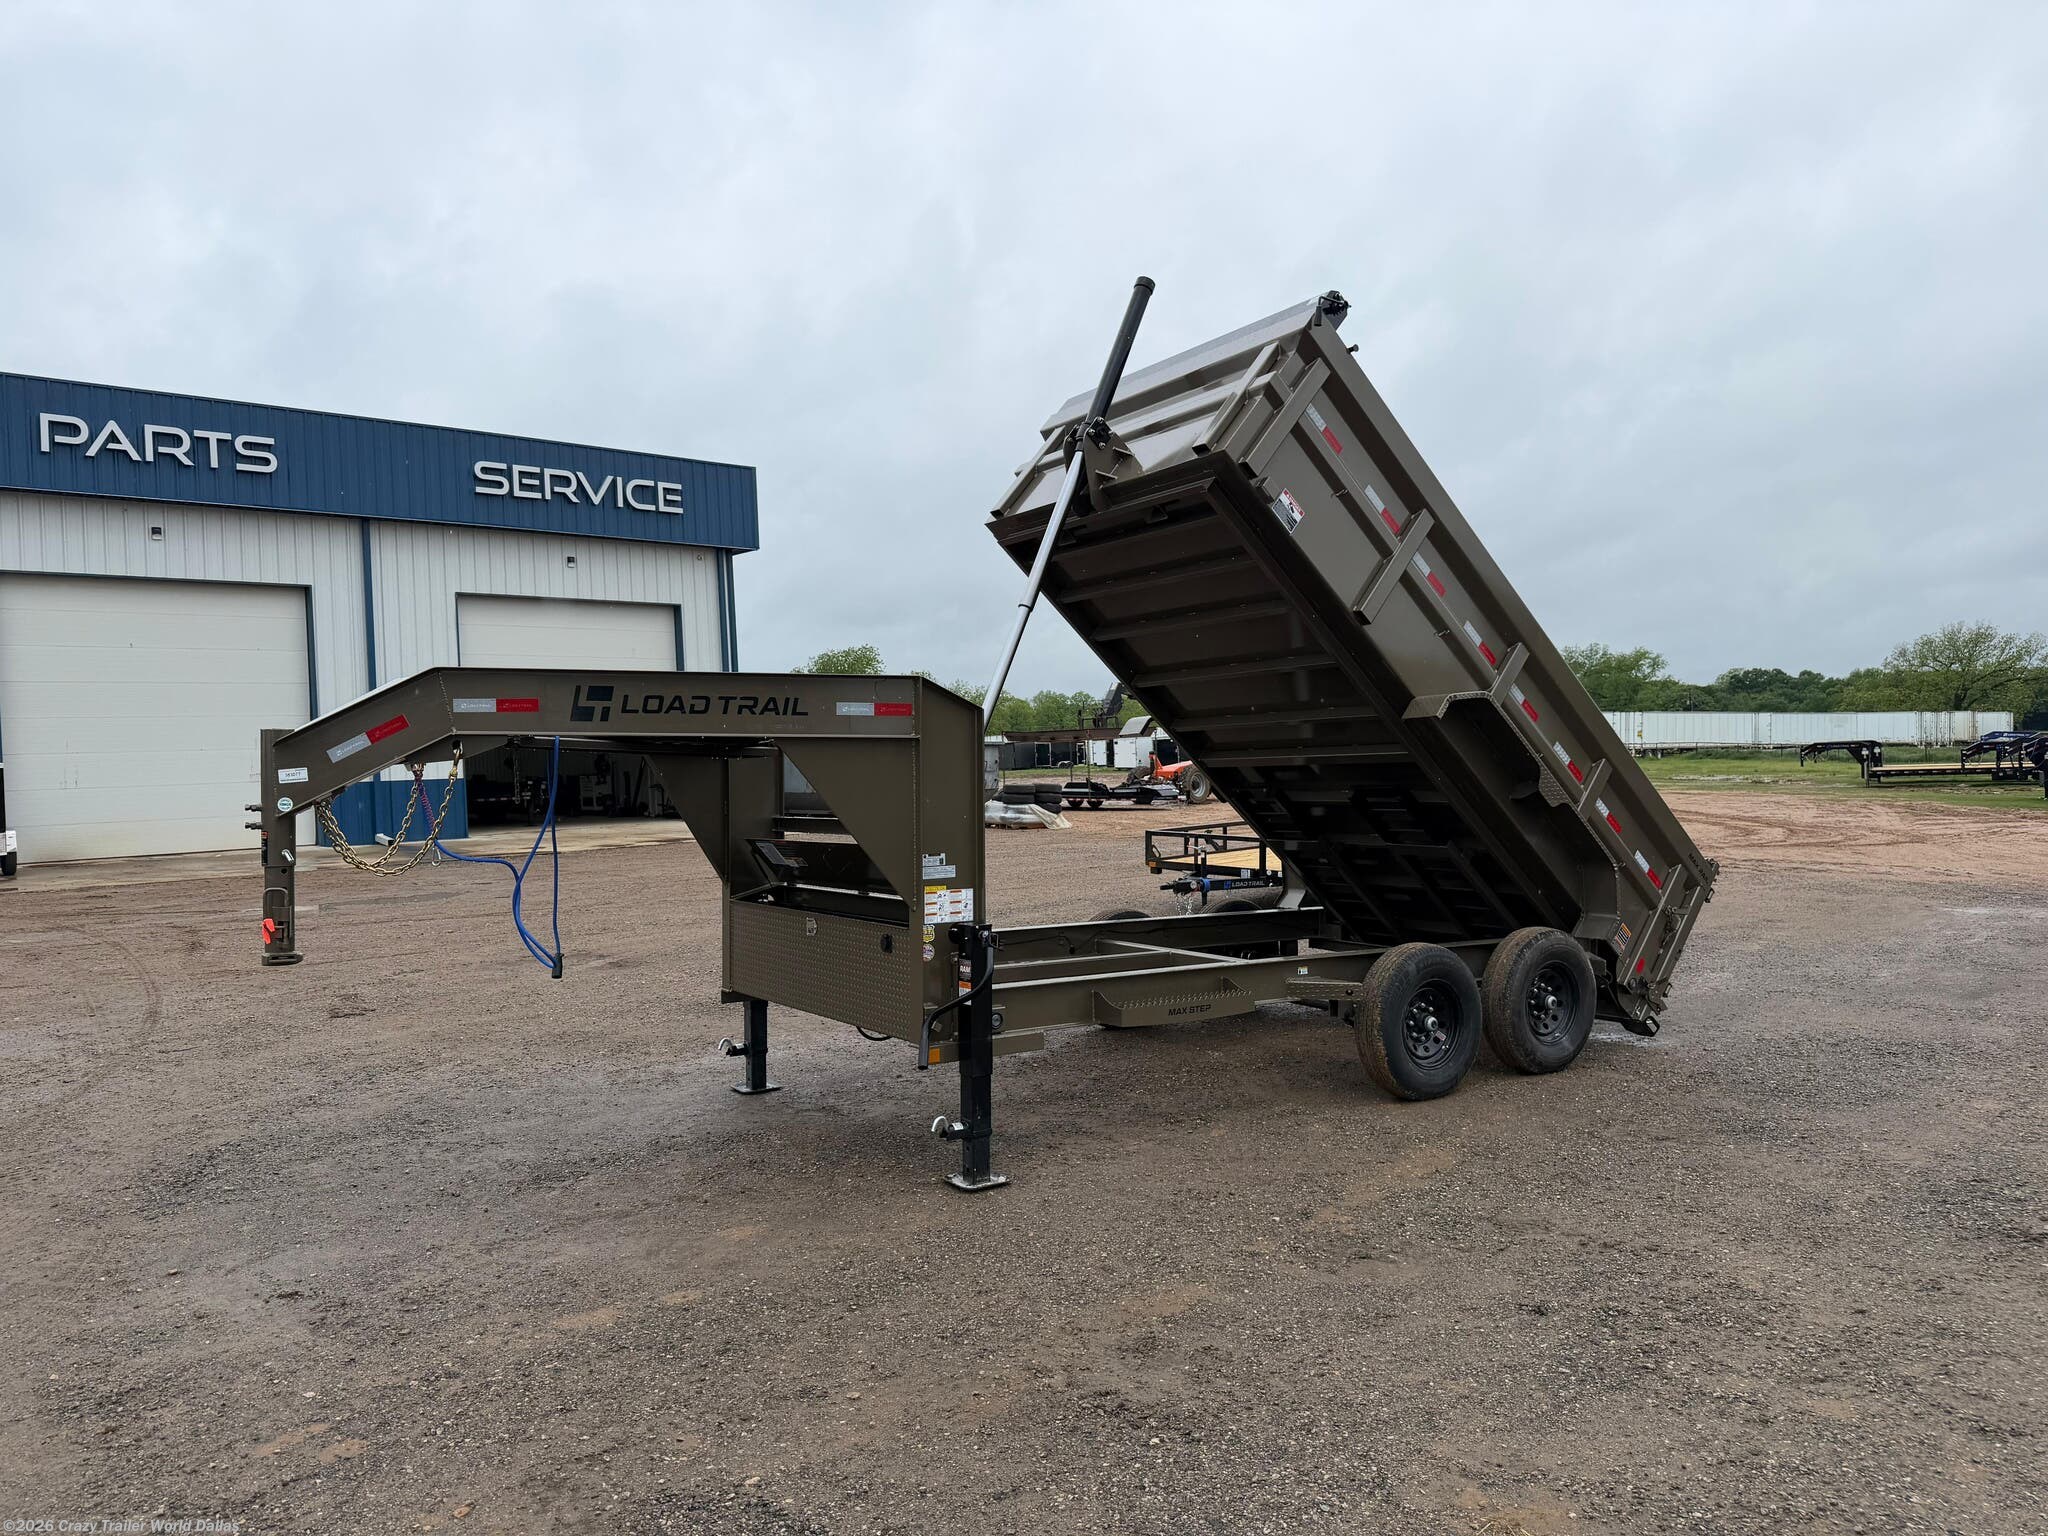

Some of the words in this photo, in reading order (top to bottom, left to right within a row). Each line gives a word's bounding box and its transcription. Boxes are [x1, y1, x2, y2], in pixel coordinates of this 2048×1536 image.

[39, 412, 278, 474] PARTS
[474, 460, 684, 514] SERVICE
[621, 694, 711, 714] LOAD
[717, 695, 809, 716] TRAIL
[959, 965, 972, 973] RAM
[1168, 1007, 1188, 1016] MAX
[1188, 1004, 1212, 1014] STEP
